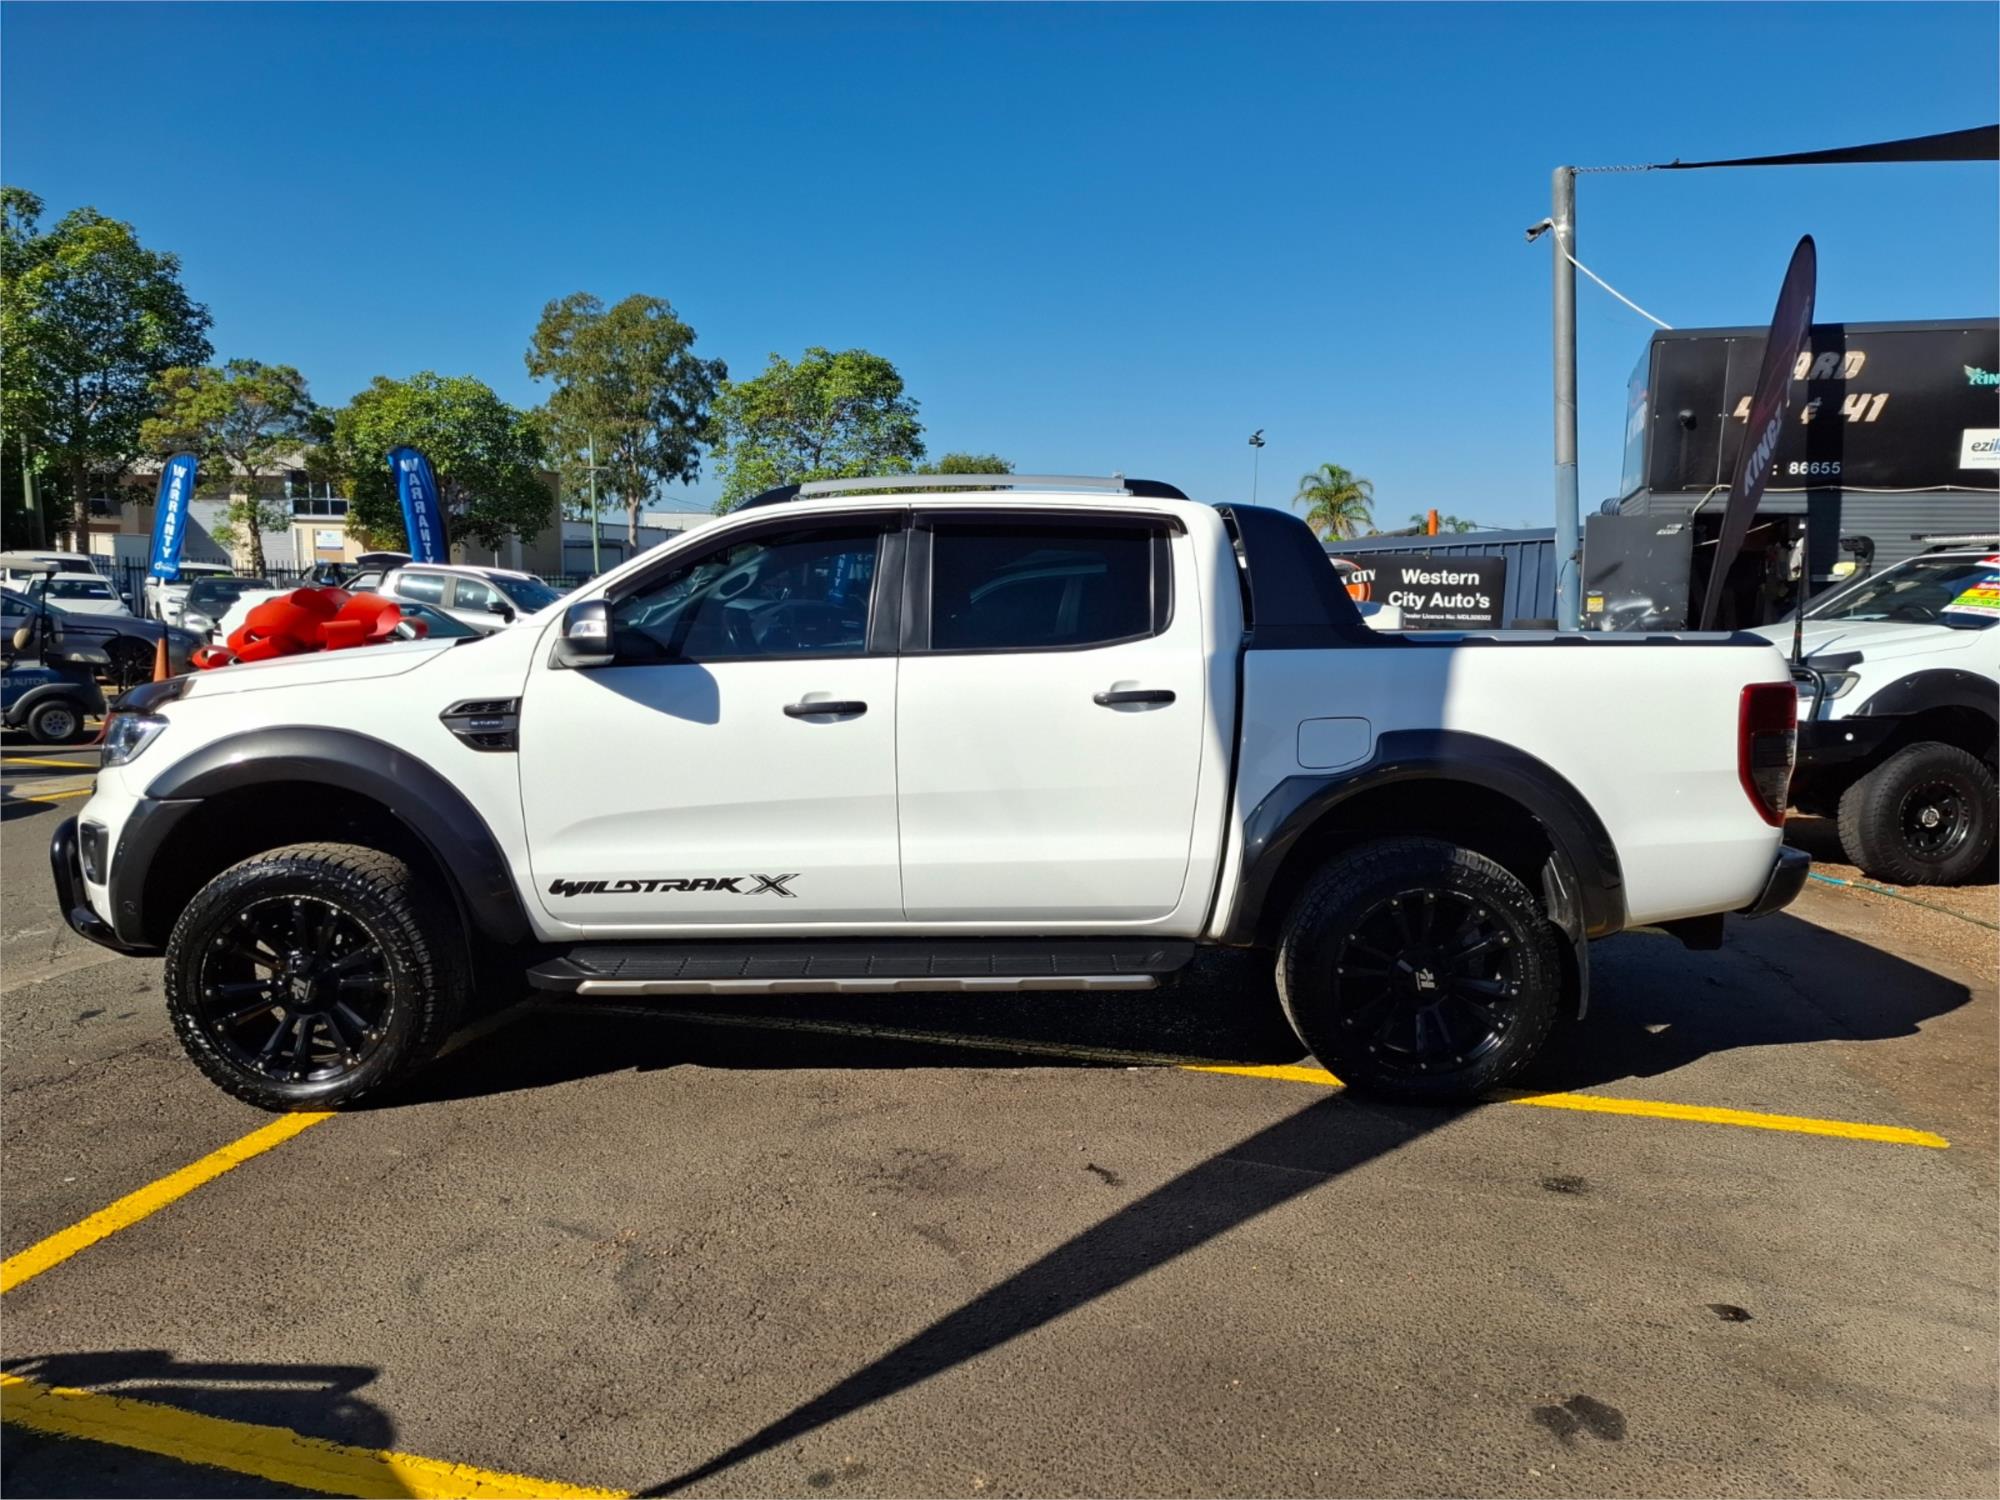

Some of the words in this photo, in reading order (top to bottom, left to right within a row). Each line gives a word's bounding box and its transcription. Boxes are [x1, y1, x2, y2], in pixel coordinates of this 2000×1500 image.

[1793, 351, 1866, 381] ARD
[1839, 393, 1889, 422] 41
[1789, 461, 1840, 475] 86655
[162, 464, 188, 558] WARRANTY
[1351, 568, 1376, 583] CITY
[1401, 568, 1480, 586] Western
[1388, 591, 1426, 610] City
[1429, 592, 1490, 608] Auto's
[548, 877, 746, 898] WILDTRAK
